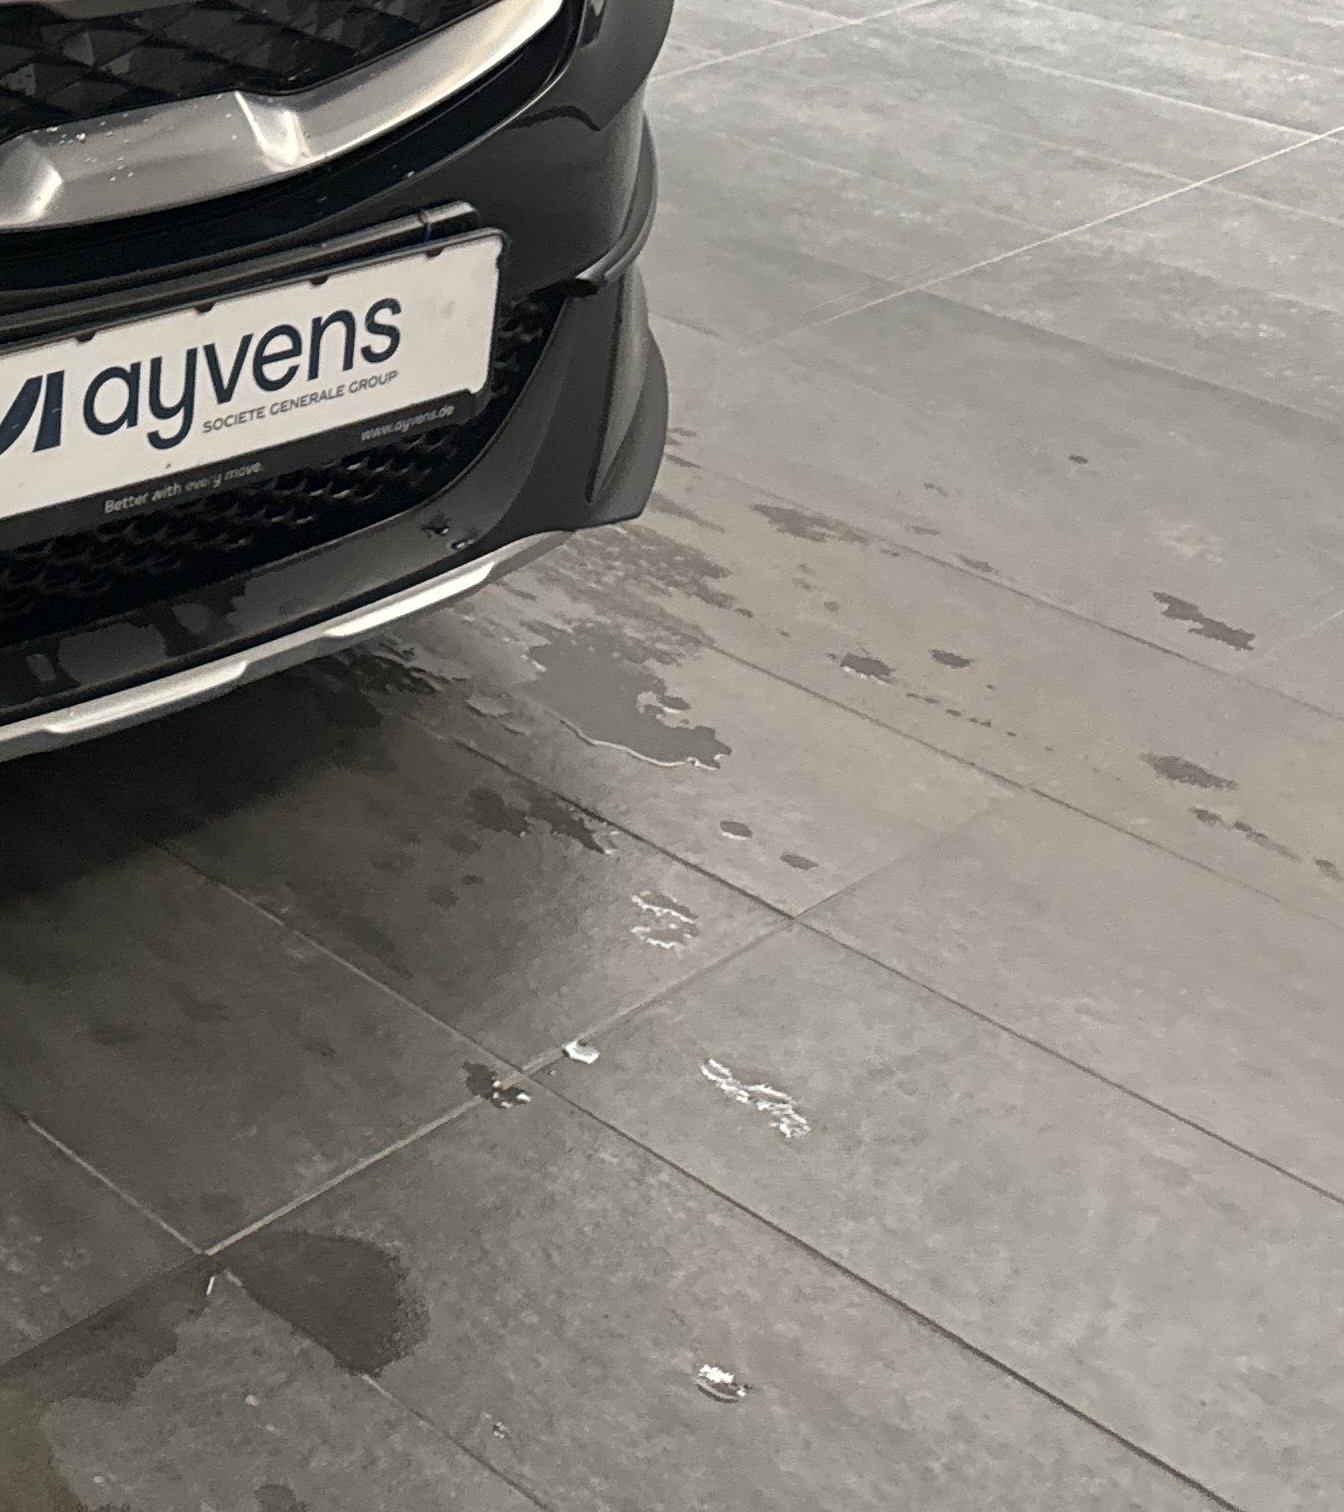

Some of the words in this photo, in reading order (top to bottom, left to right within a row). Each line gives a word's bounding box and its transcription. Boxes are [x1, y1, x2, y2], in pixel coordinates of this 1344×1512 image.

[83, 297, 402, 450] ayvens
[202, 405, 267, 434] SOCIETE
[269, 384, 346, 416] GENERALE
[348, 369, 399, 394] GROUP
[104, 492, 149, 514] Better
[151, 482, 183, 502] with
